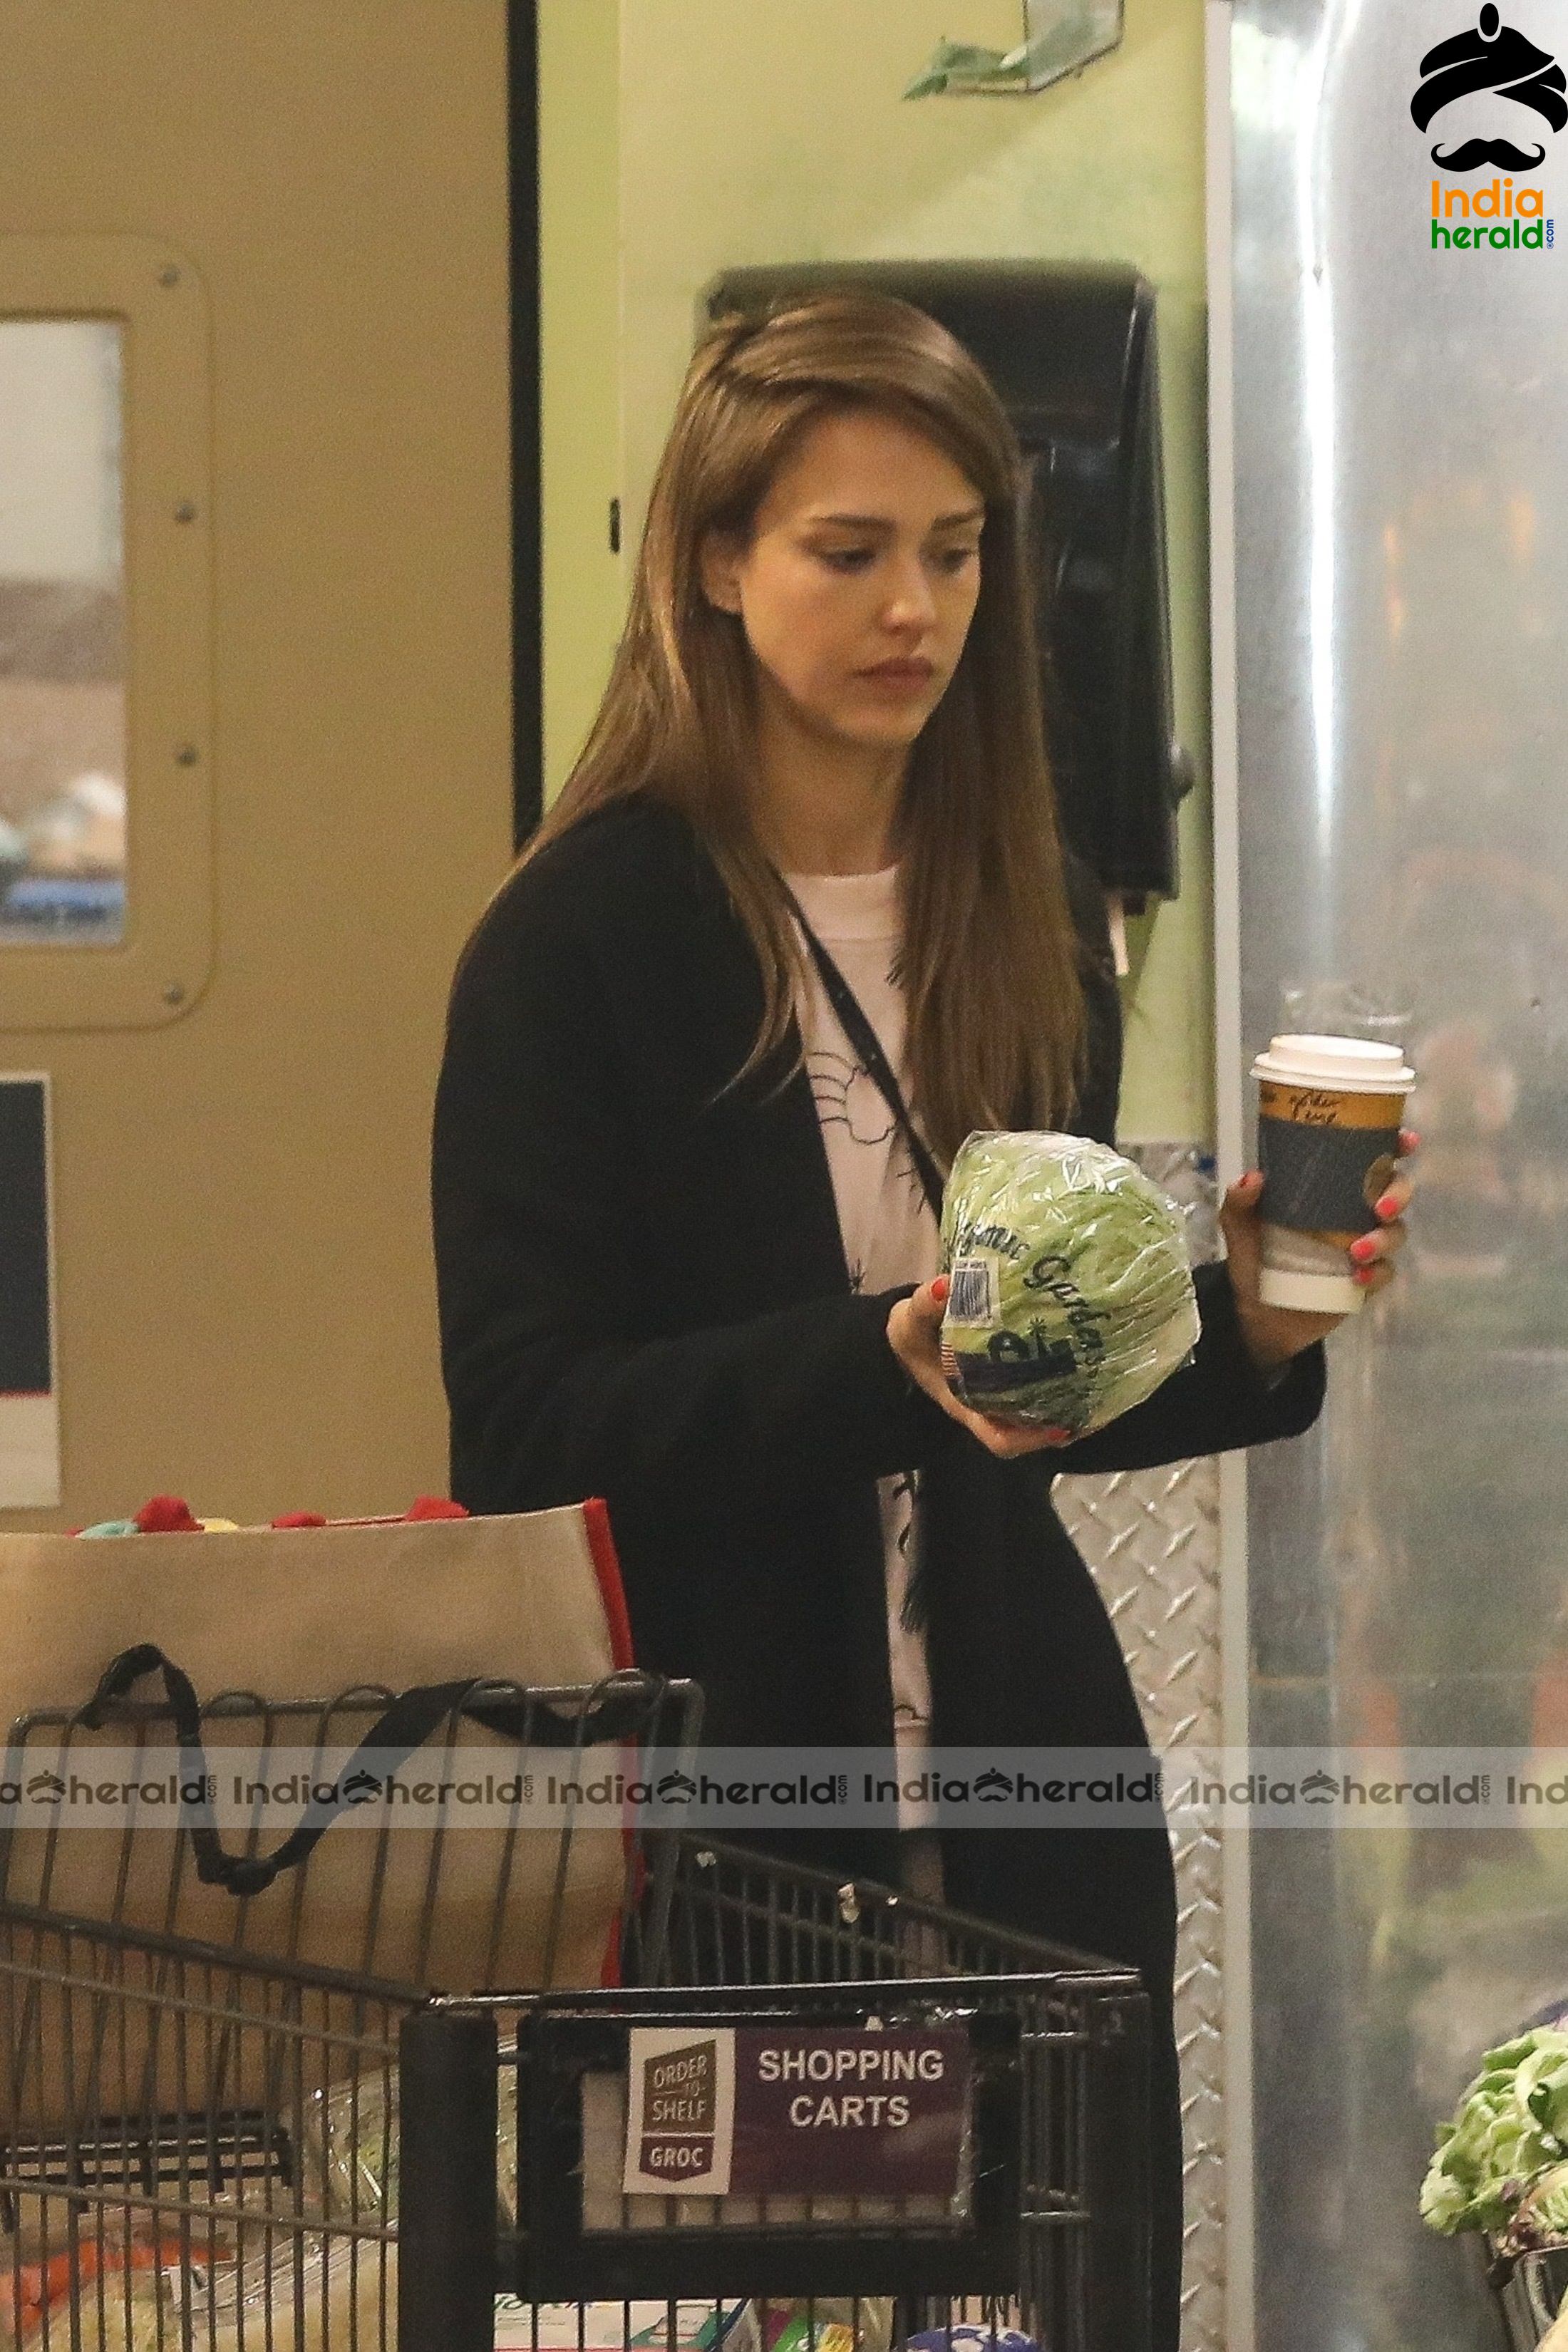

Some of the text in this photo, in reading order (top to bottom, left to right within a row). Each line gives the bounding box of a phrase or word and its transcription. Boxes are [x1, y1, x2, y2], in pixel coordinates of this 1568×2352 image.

[654, 2054, 708, 2089] ORDER
[758, 2048, 945, 2082] SHOPPING
[651, 2100, 706, 2122] SHELF
[789, 2094, 911, 2127] CARTS
[649, 2147, 703, 2168] GROC
